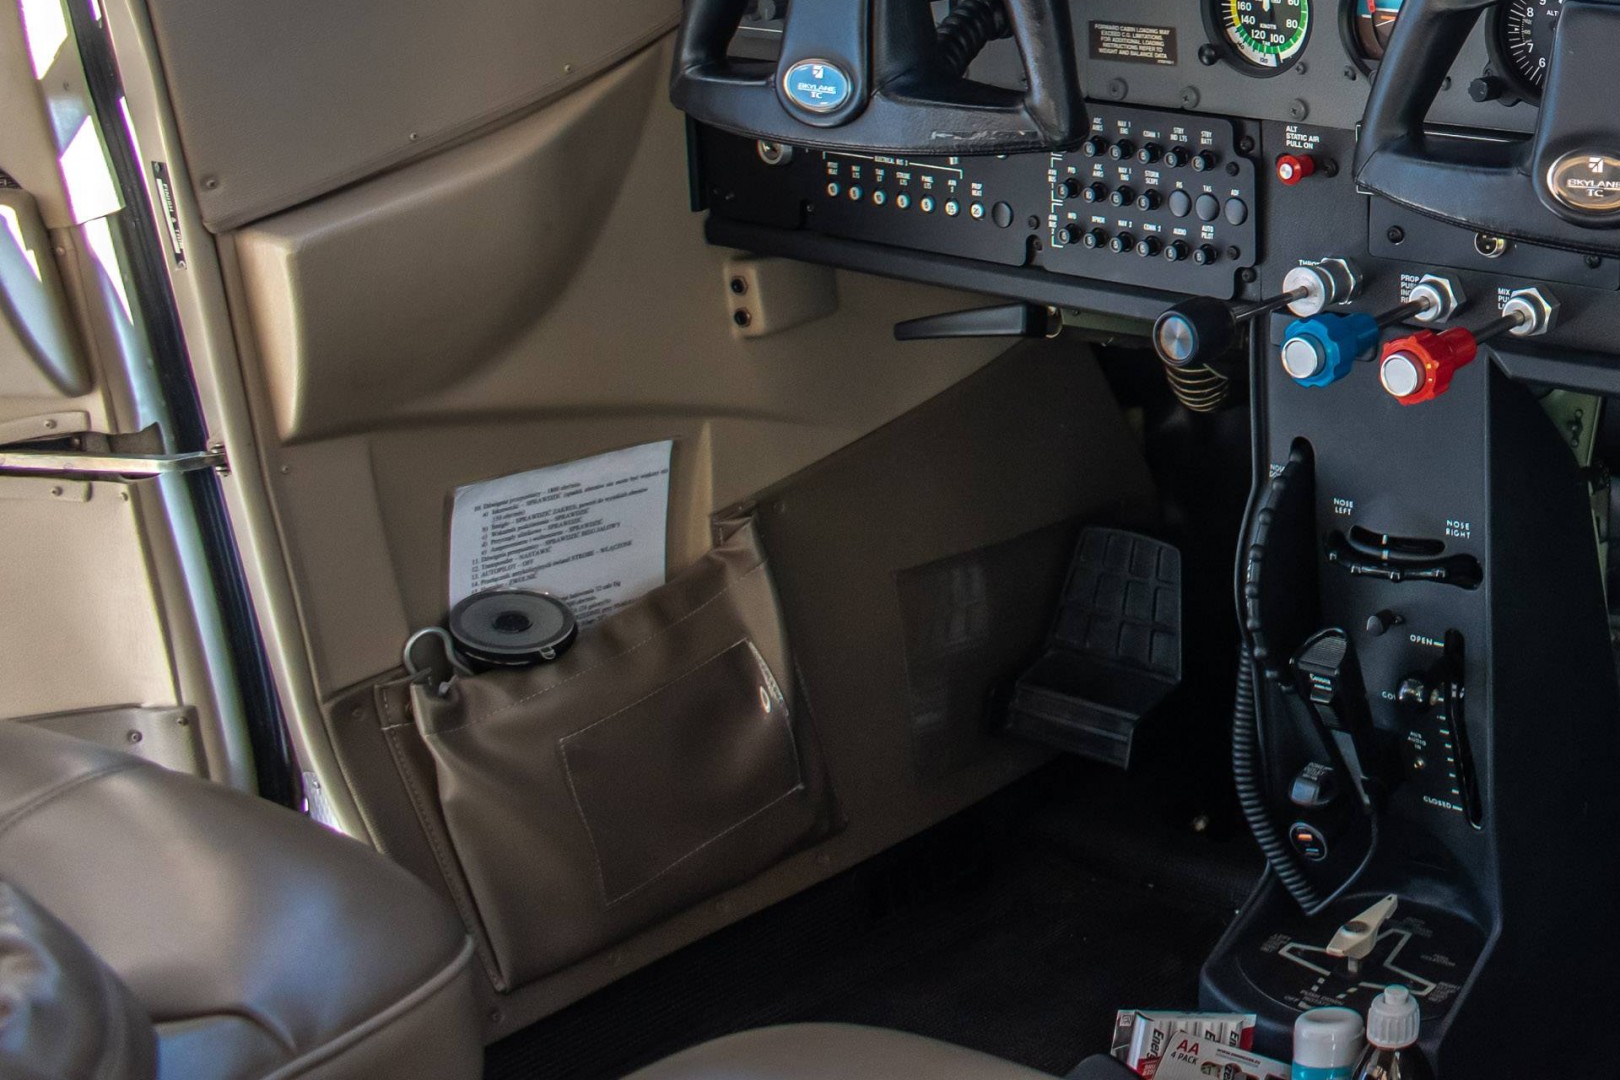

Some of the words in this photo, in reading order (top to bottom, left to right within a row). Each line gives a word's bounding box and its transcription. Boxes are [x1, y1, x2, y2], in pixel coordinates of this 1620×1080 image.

[1237, 1, 1252, 11] 160
[1526, 7, 1534, 17] 8
[1241, 15, 1256, 25] 140
[1286, 19, 1298, 29] 80
[1251, 30, 1266, 40] 120
[1270, 34, 1285, 44] 100
[1527, 42, 1534, 53] 7
[1538, 57, 1546, 68] 6
[810, 91, 823, 99] TC
[1286, 132, 1308, 142] STATIC
[1308, 135, 1320, 143] AIR
[1286, 140, 1303, 148] PULL
[1586, 189, 1604, 197] TC
[1400, 274, 1420, 283] PROP
[1400, 281, 1417, 289] PUS
[1497, 288, 1511, 296] MIX
[1333, 498, 1354, 508] NOSE
[1334, 506, 1351, 516] LEFT
[1446, 520, 1470, 530] NOSE
[1445, 529, 1471, 539] RIGHT
[1409, 634, 1433, 646] OPEN
[1407, 736, 1427, 747] AUDIO
[1423, 795, 1452, 809] CLOSED
[1176, 1039, 1200, 1056] AA
[1177, 1053, 1199, 1066] PACK
